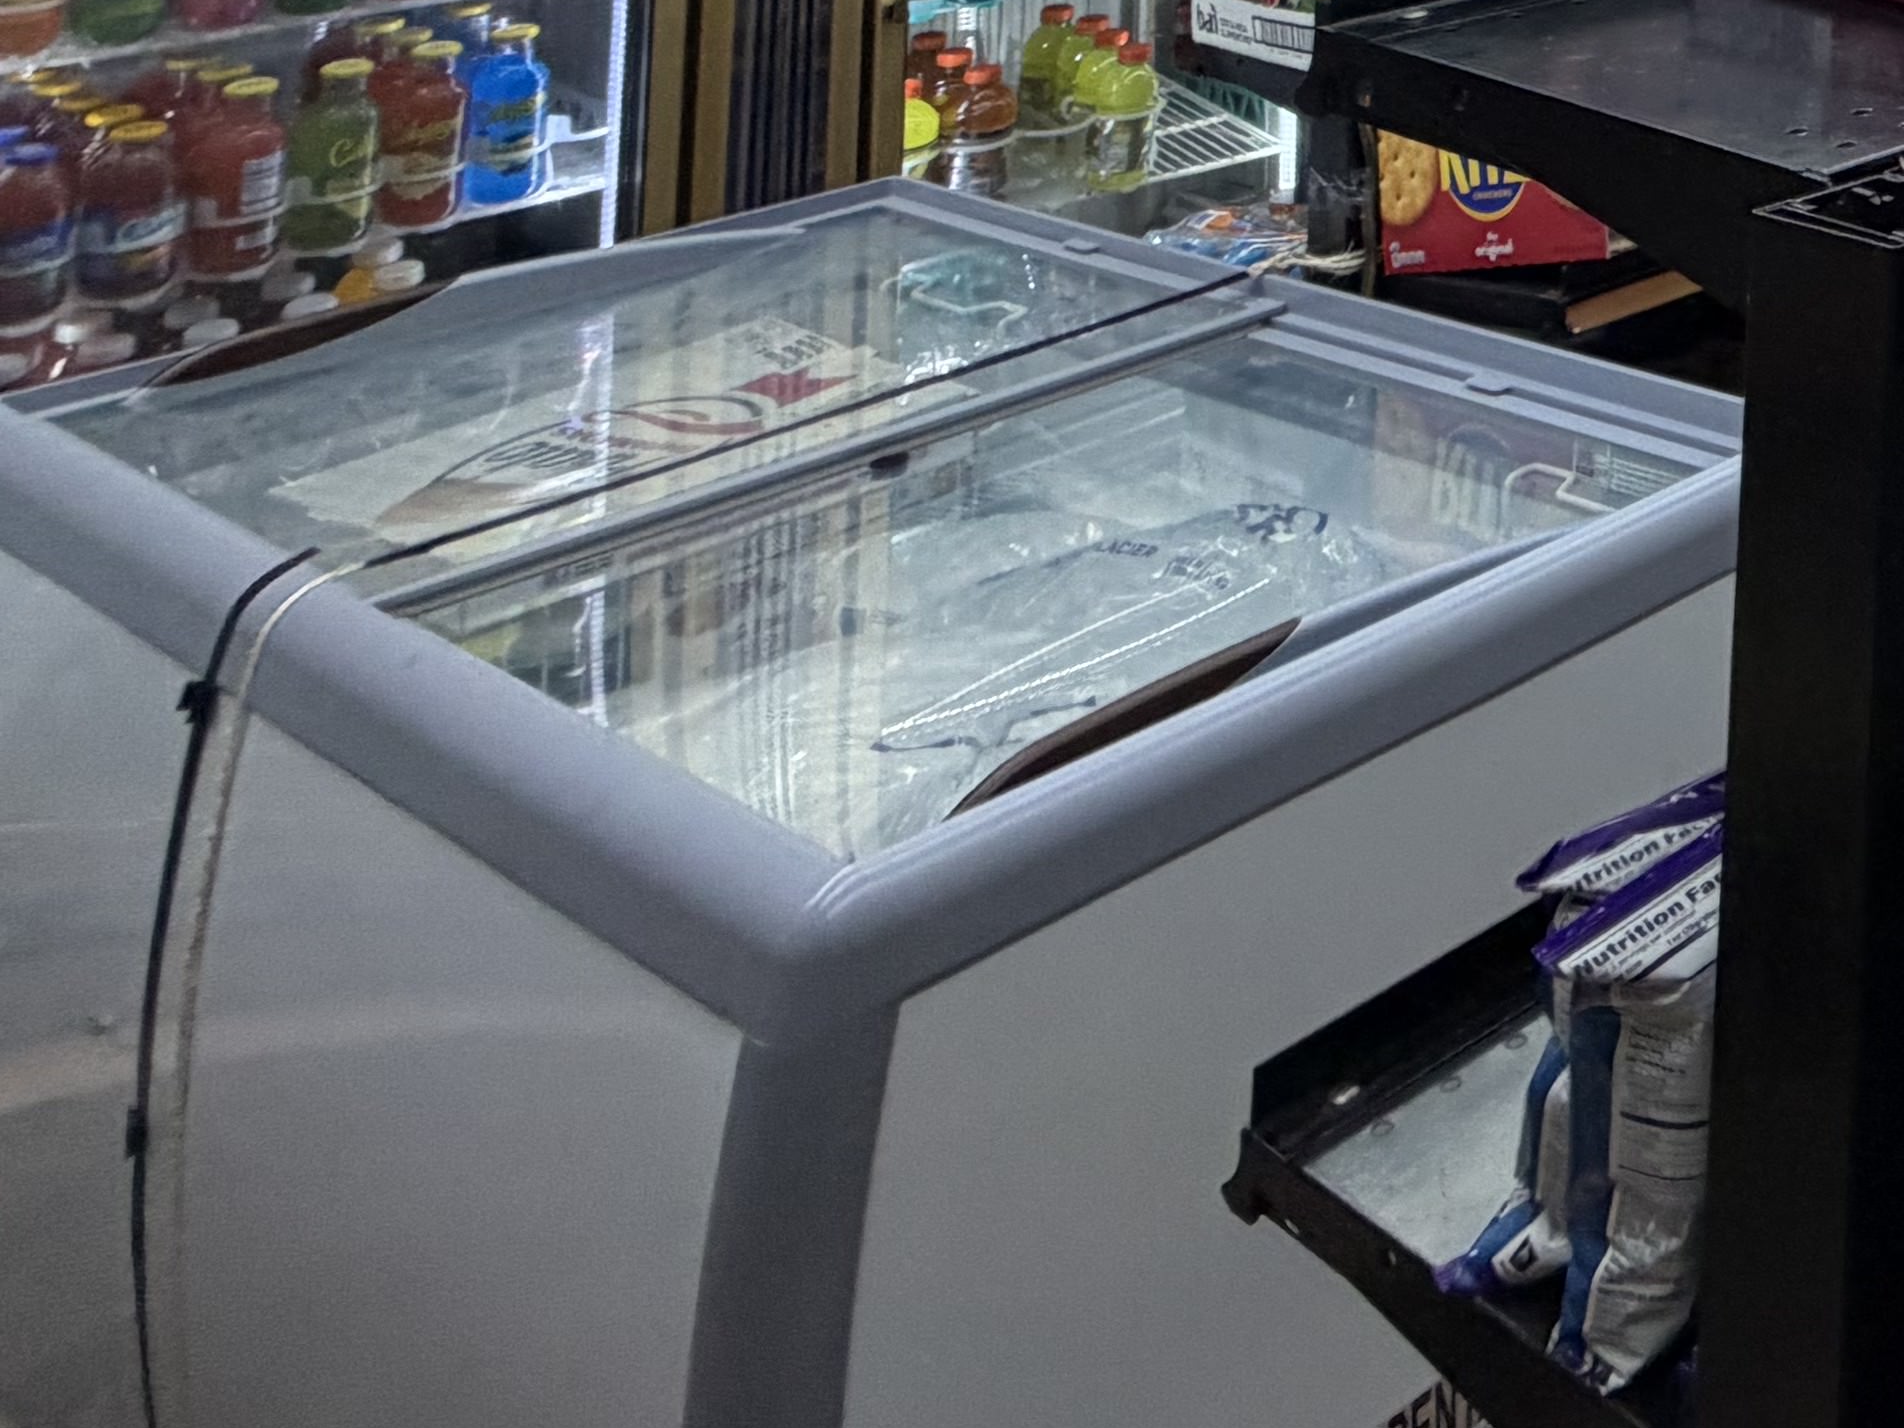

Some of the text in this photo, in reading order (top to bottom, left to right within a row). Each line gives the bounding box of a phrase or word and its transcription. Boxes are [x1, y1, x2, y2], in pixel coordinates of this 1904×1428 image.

[1196, 1, 1218, 35] bai
[1475, 239, 1514, 261] original
[1572, 899, 1686, 976] Nutrition
